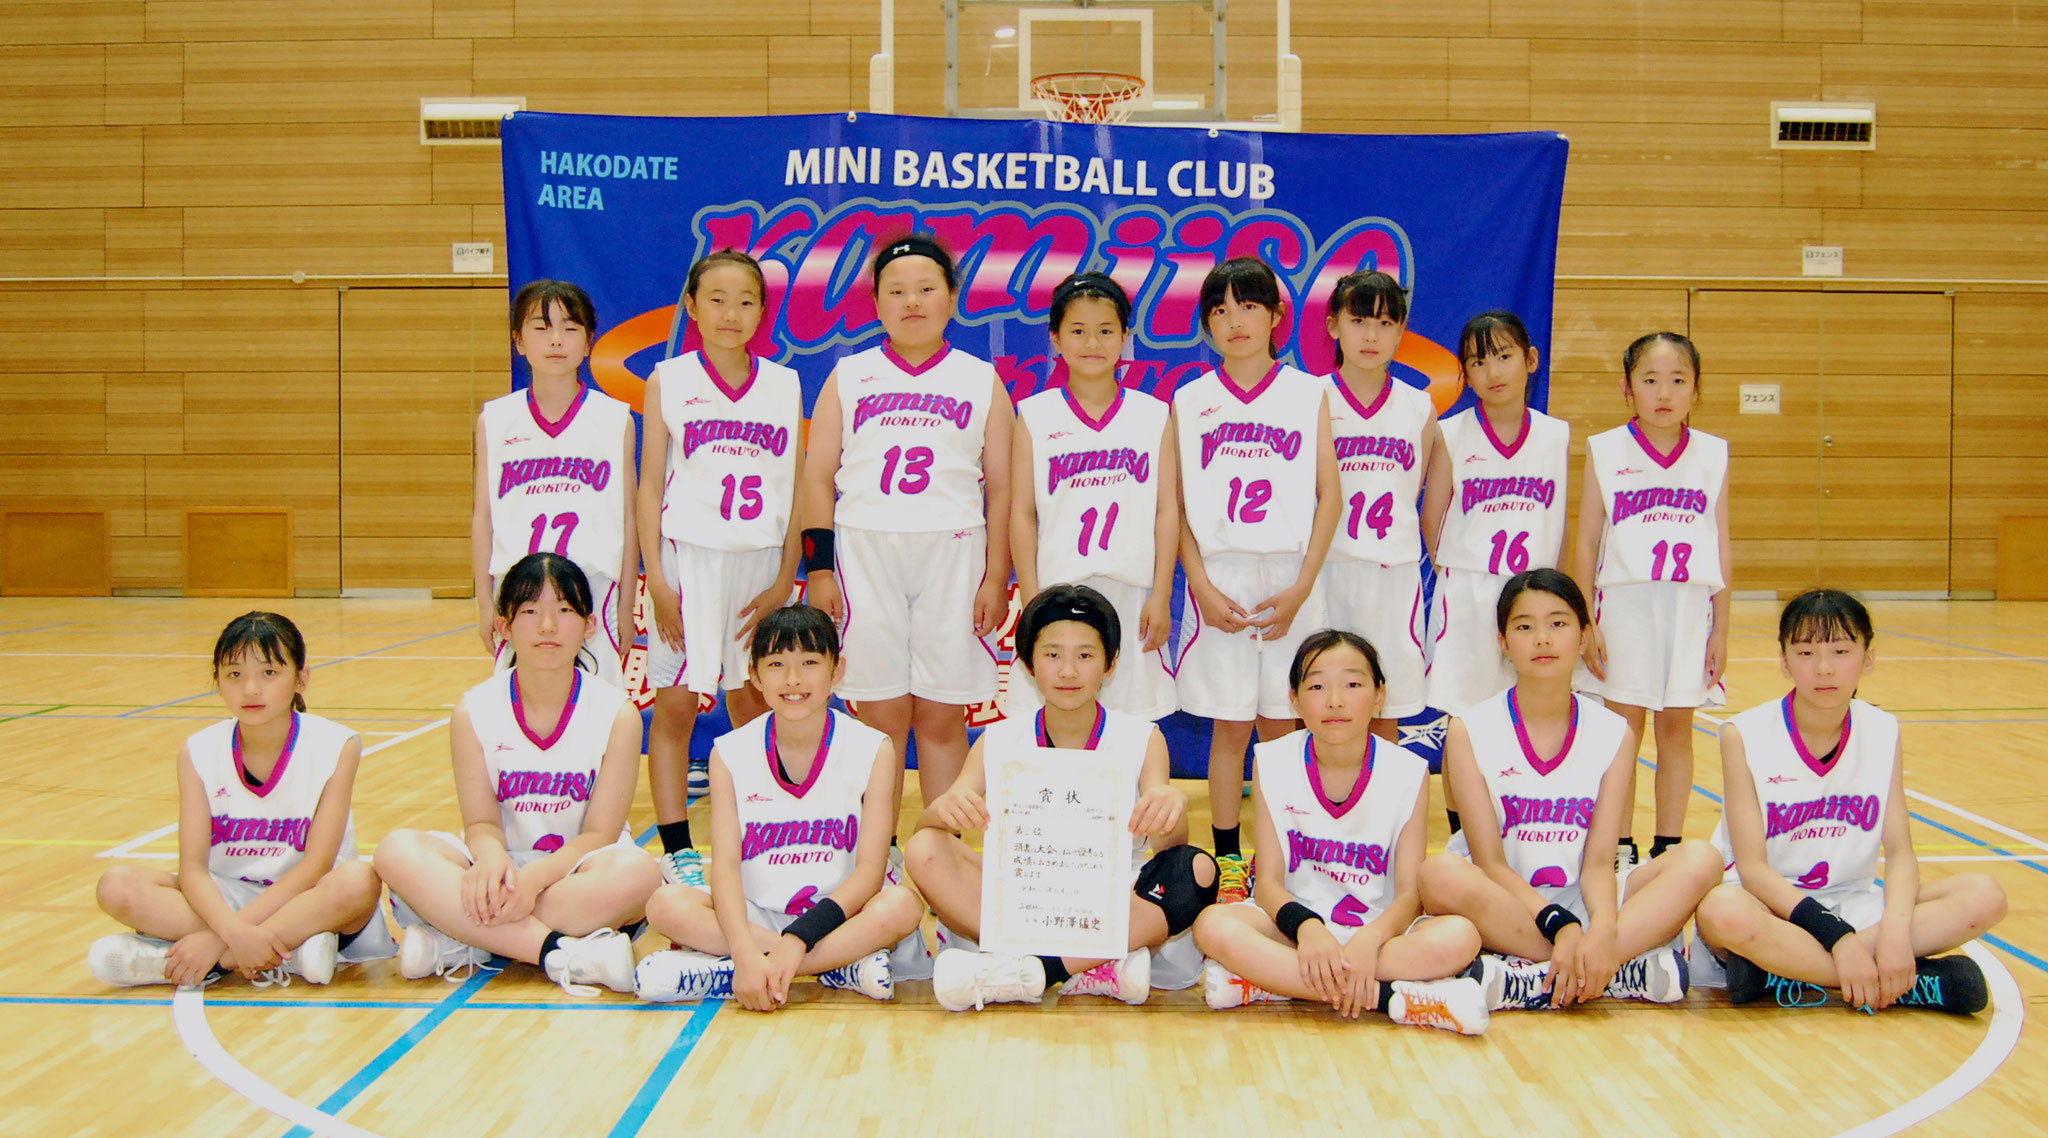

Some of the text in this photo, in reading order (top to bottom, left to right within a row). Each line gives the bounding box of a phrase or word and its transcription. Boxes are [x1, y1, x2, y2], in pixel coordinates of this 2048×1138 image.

[540, 150, 679, 180] HAKODATE
[785, 146, 1276, 200] MINI BASKETBALL CLUB
[538, 184, 604, 210] AREA
[1743, 393, 1776, 403] フェンス
[880, 416, 941, 429] HOKUTO
[712, 445, 760, 458] HOKUTO
[1220, 446, 1273, 459] HOKUTO
[1334, 436, 1415, 471] amiiso
[880, 445, 934, 495] 13
[1341, 462, 1395, 472] HOKUTO
[1070, 472, 1127, 488] HOKUTO
[525, 482, 581, 495] HOKUTO
[720, 474, 763, 521] 15
[1227, 477, 1272, 524] 12
[1483, 501, 1535, 513] HOKUTO
[1347, 491, 1394, 540] 14
[1642, 513, 1695, 525] HOKUTO
[528, 512, 579, 557] 17
[1078, 502, 1119, 557] 11
[1488, 529, 1529, 577] 16
[1651, 539, 1693, 583] 18
[514, 800, 571, 813] HOKUTO
[1517, 829, 1579, 842] HOKUTO
[1790, 825, 1847, 842] HOKUTO
[225, 846, 287, 857] HOKUTO
[768, 851, 834, 865] HOKUTO
